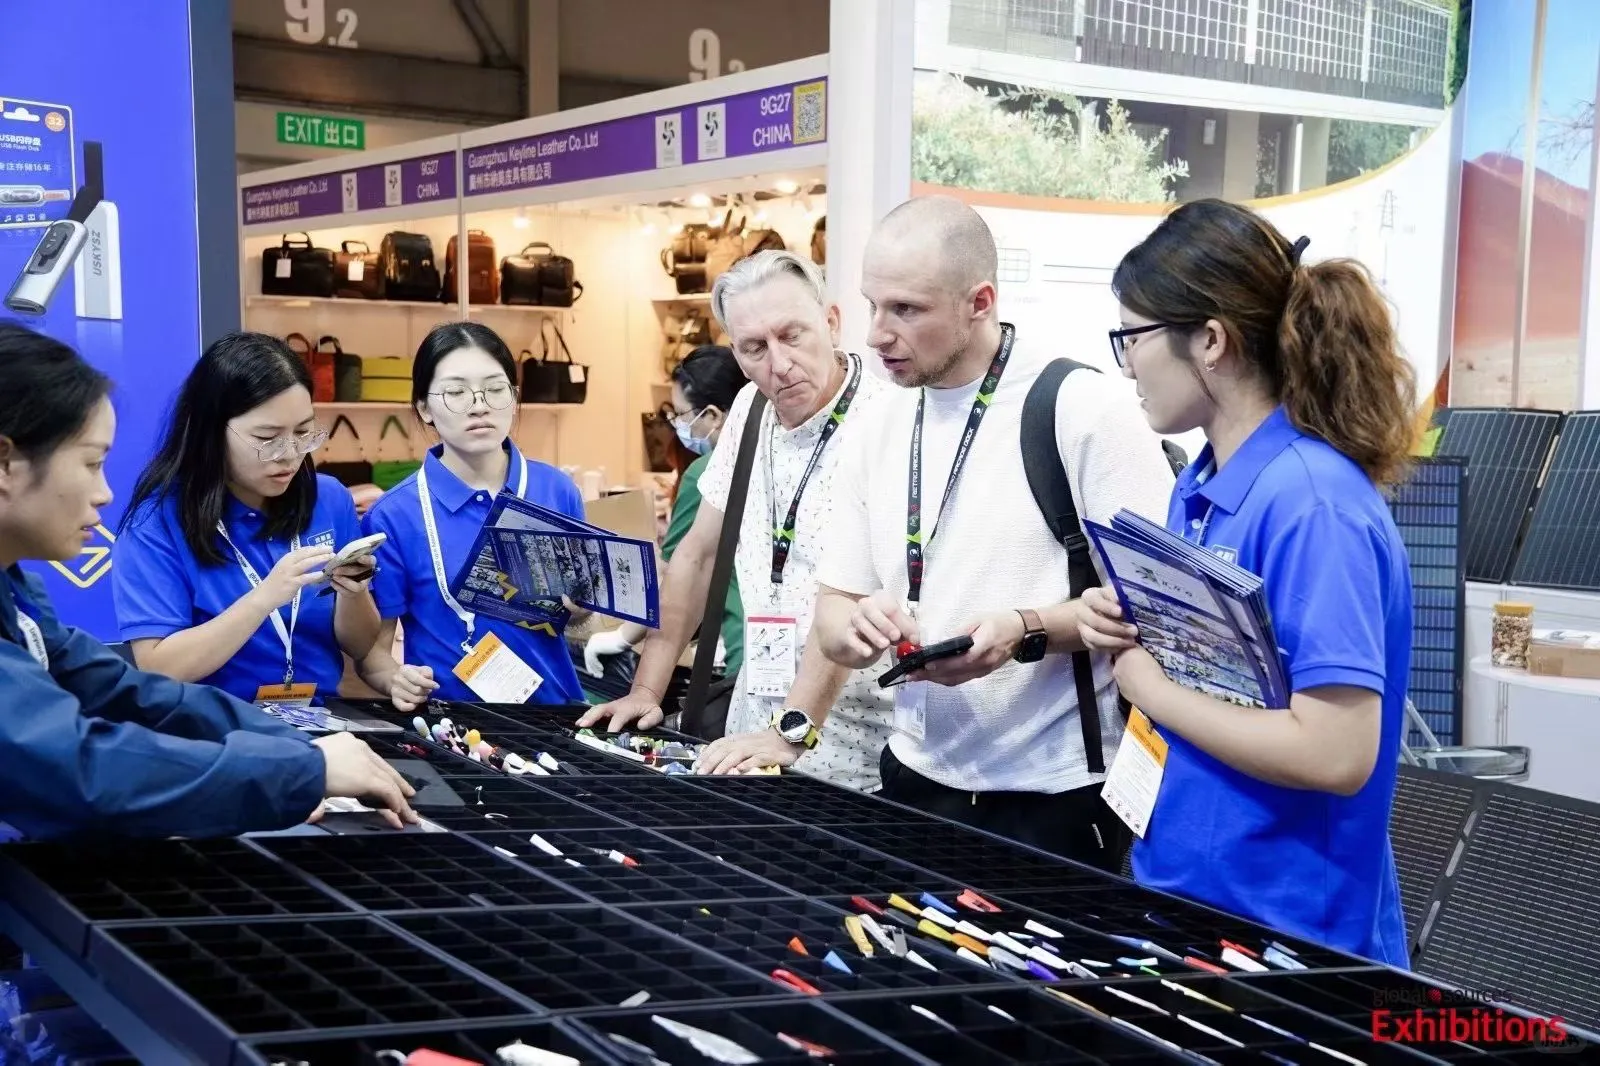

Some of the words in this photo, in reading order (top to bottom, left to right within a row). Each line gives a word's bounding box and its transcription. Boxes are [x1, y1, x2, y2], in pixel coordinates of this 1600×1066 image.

[760, 92, 791, 116] 9G27
[284, 115, 322, 144] EXIT
[324, 120, 358, 146] 出口
[753, 124, 792, 147] CHINA
[468, 151, 508, 169] Guangzhou
[508, 144, 537, 163] Keyline
[537, 138, 568, 156] Leather
[421, 160, 439, 176] 9G27
[417, 183, 440, 199] CHINA
[92, 230, 102, 276] USKYSZ
[963, 427, 975, 447] DOCK
